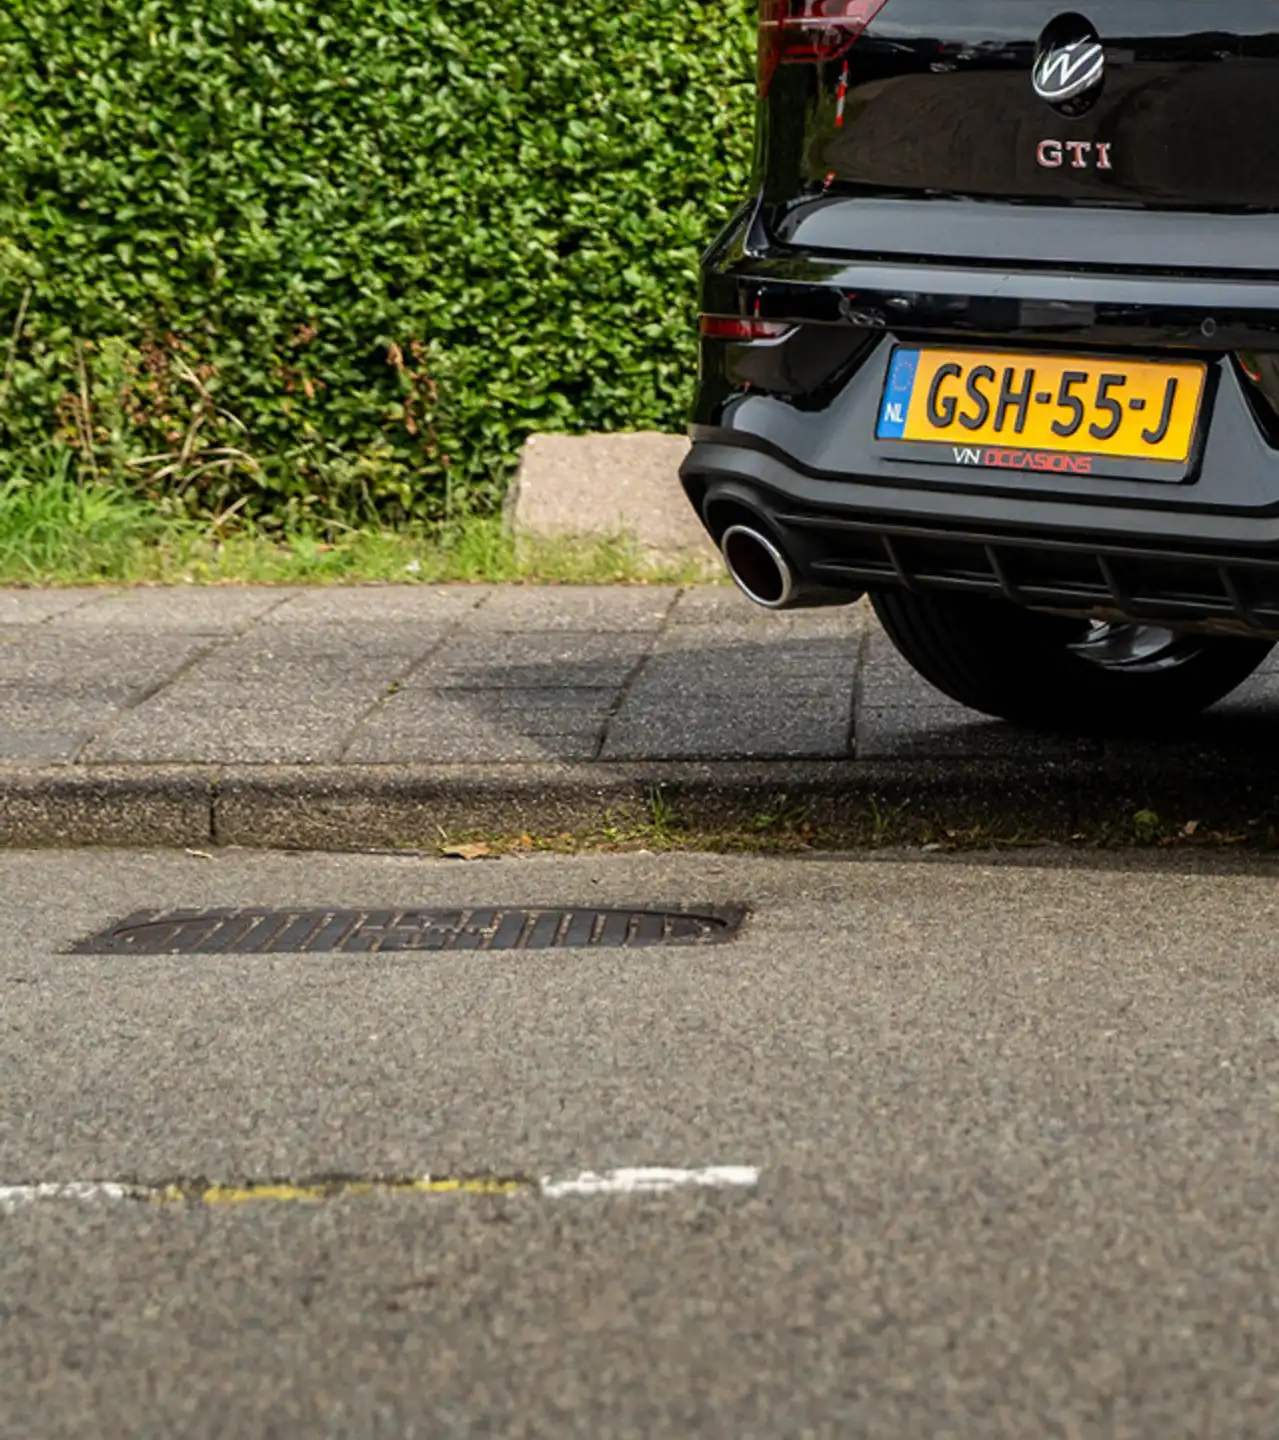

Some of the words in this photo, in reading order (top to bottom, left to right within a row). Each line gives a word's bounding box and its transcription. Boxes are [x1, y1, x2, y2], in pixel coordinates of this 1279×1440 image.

[1036, 139, 1112, 169] GTI
[884, 402, 904, 423] NL
[925, 363, 1178, 445] GSH-55-J
[952, 446, 982, 464] VN
[984, 448, 1093, 473] OCCASIONS
